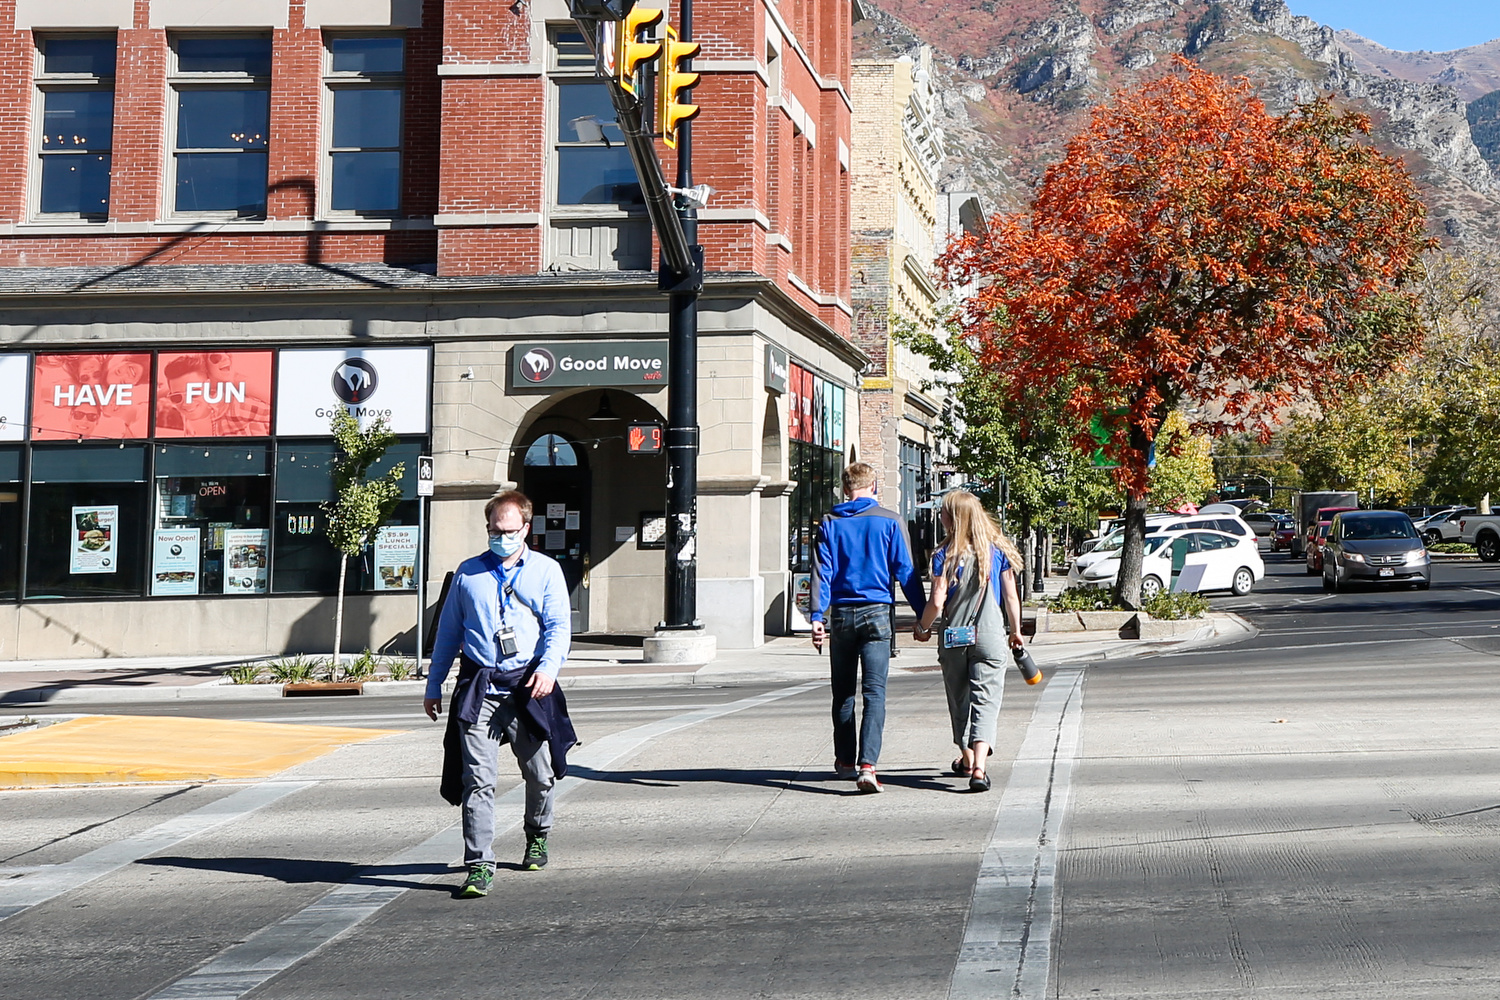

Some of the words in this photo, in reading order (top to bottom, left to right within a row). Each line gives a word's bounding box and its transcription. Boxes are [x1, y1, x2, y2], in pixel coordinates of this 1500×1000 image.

[559, 355, 607, 371] Good
[613, 355, 662, 370] Move
[53, 383, 133, 407] HAVE
[186, 381, 246, 404] FUN
[356, 407, 392, 417] Move
[652, 428, 661, 449] 9
[199, 486, 226, 496] OPEN
